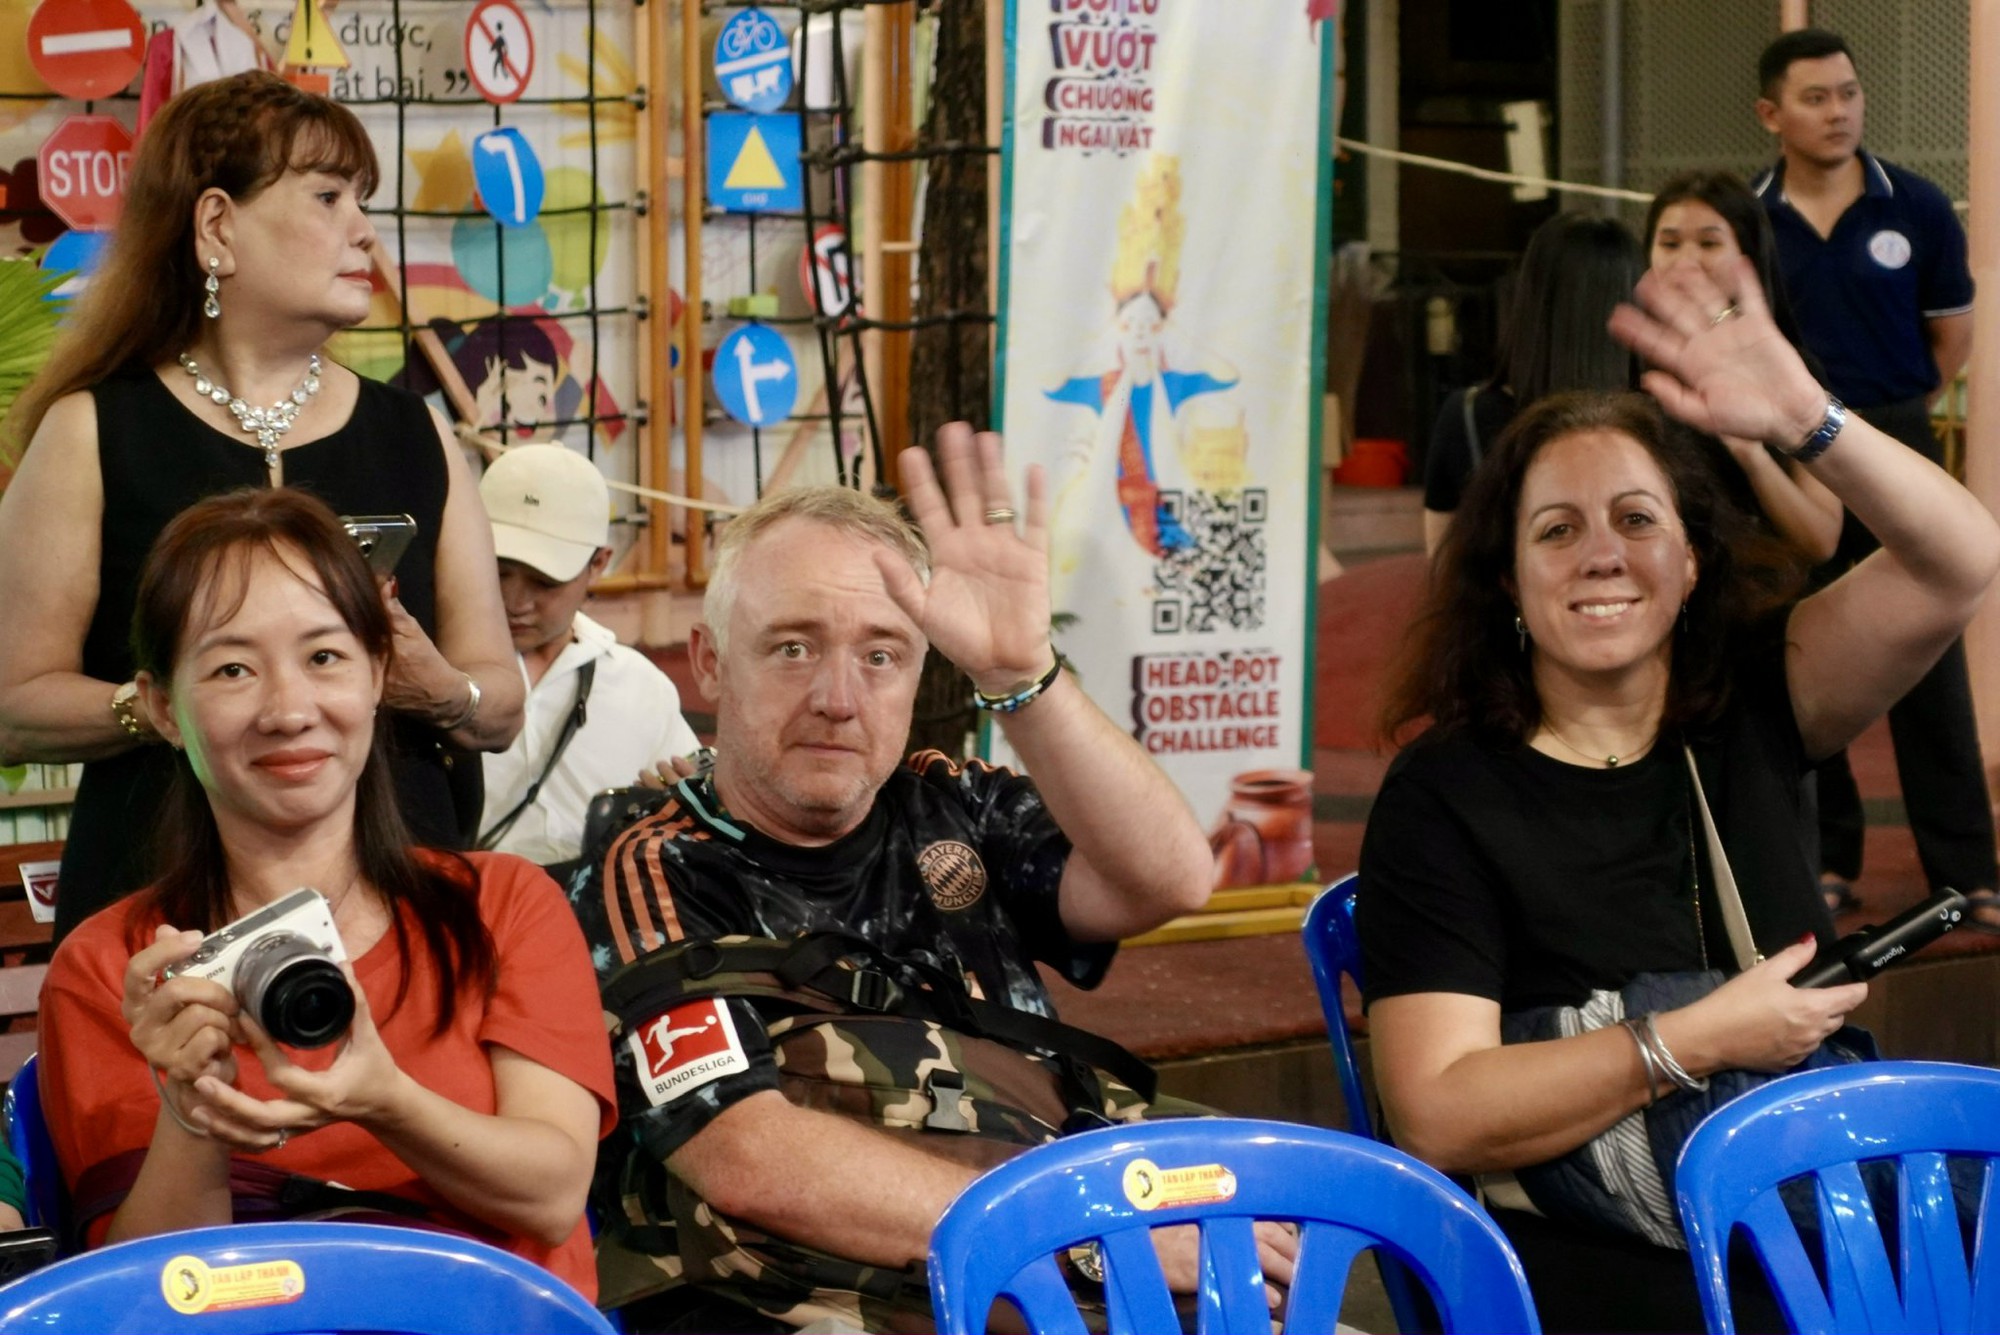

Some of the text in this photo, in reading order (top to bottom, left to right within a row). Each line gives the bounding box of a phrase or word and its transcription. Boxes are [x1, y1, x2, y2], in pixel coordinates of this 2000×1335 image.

[1147, 656, 1281, 687] HEAD-POT
[1147, 690, 1279, 722] OBSTACLE
[1146, 725, 1279, 753] CHALLENGE
[922, 843, 973, 866] BAYERN
[206, 965, 226, 981] non
[654, 1055, 736, 1094] BUNDESLIGA
